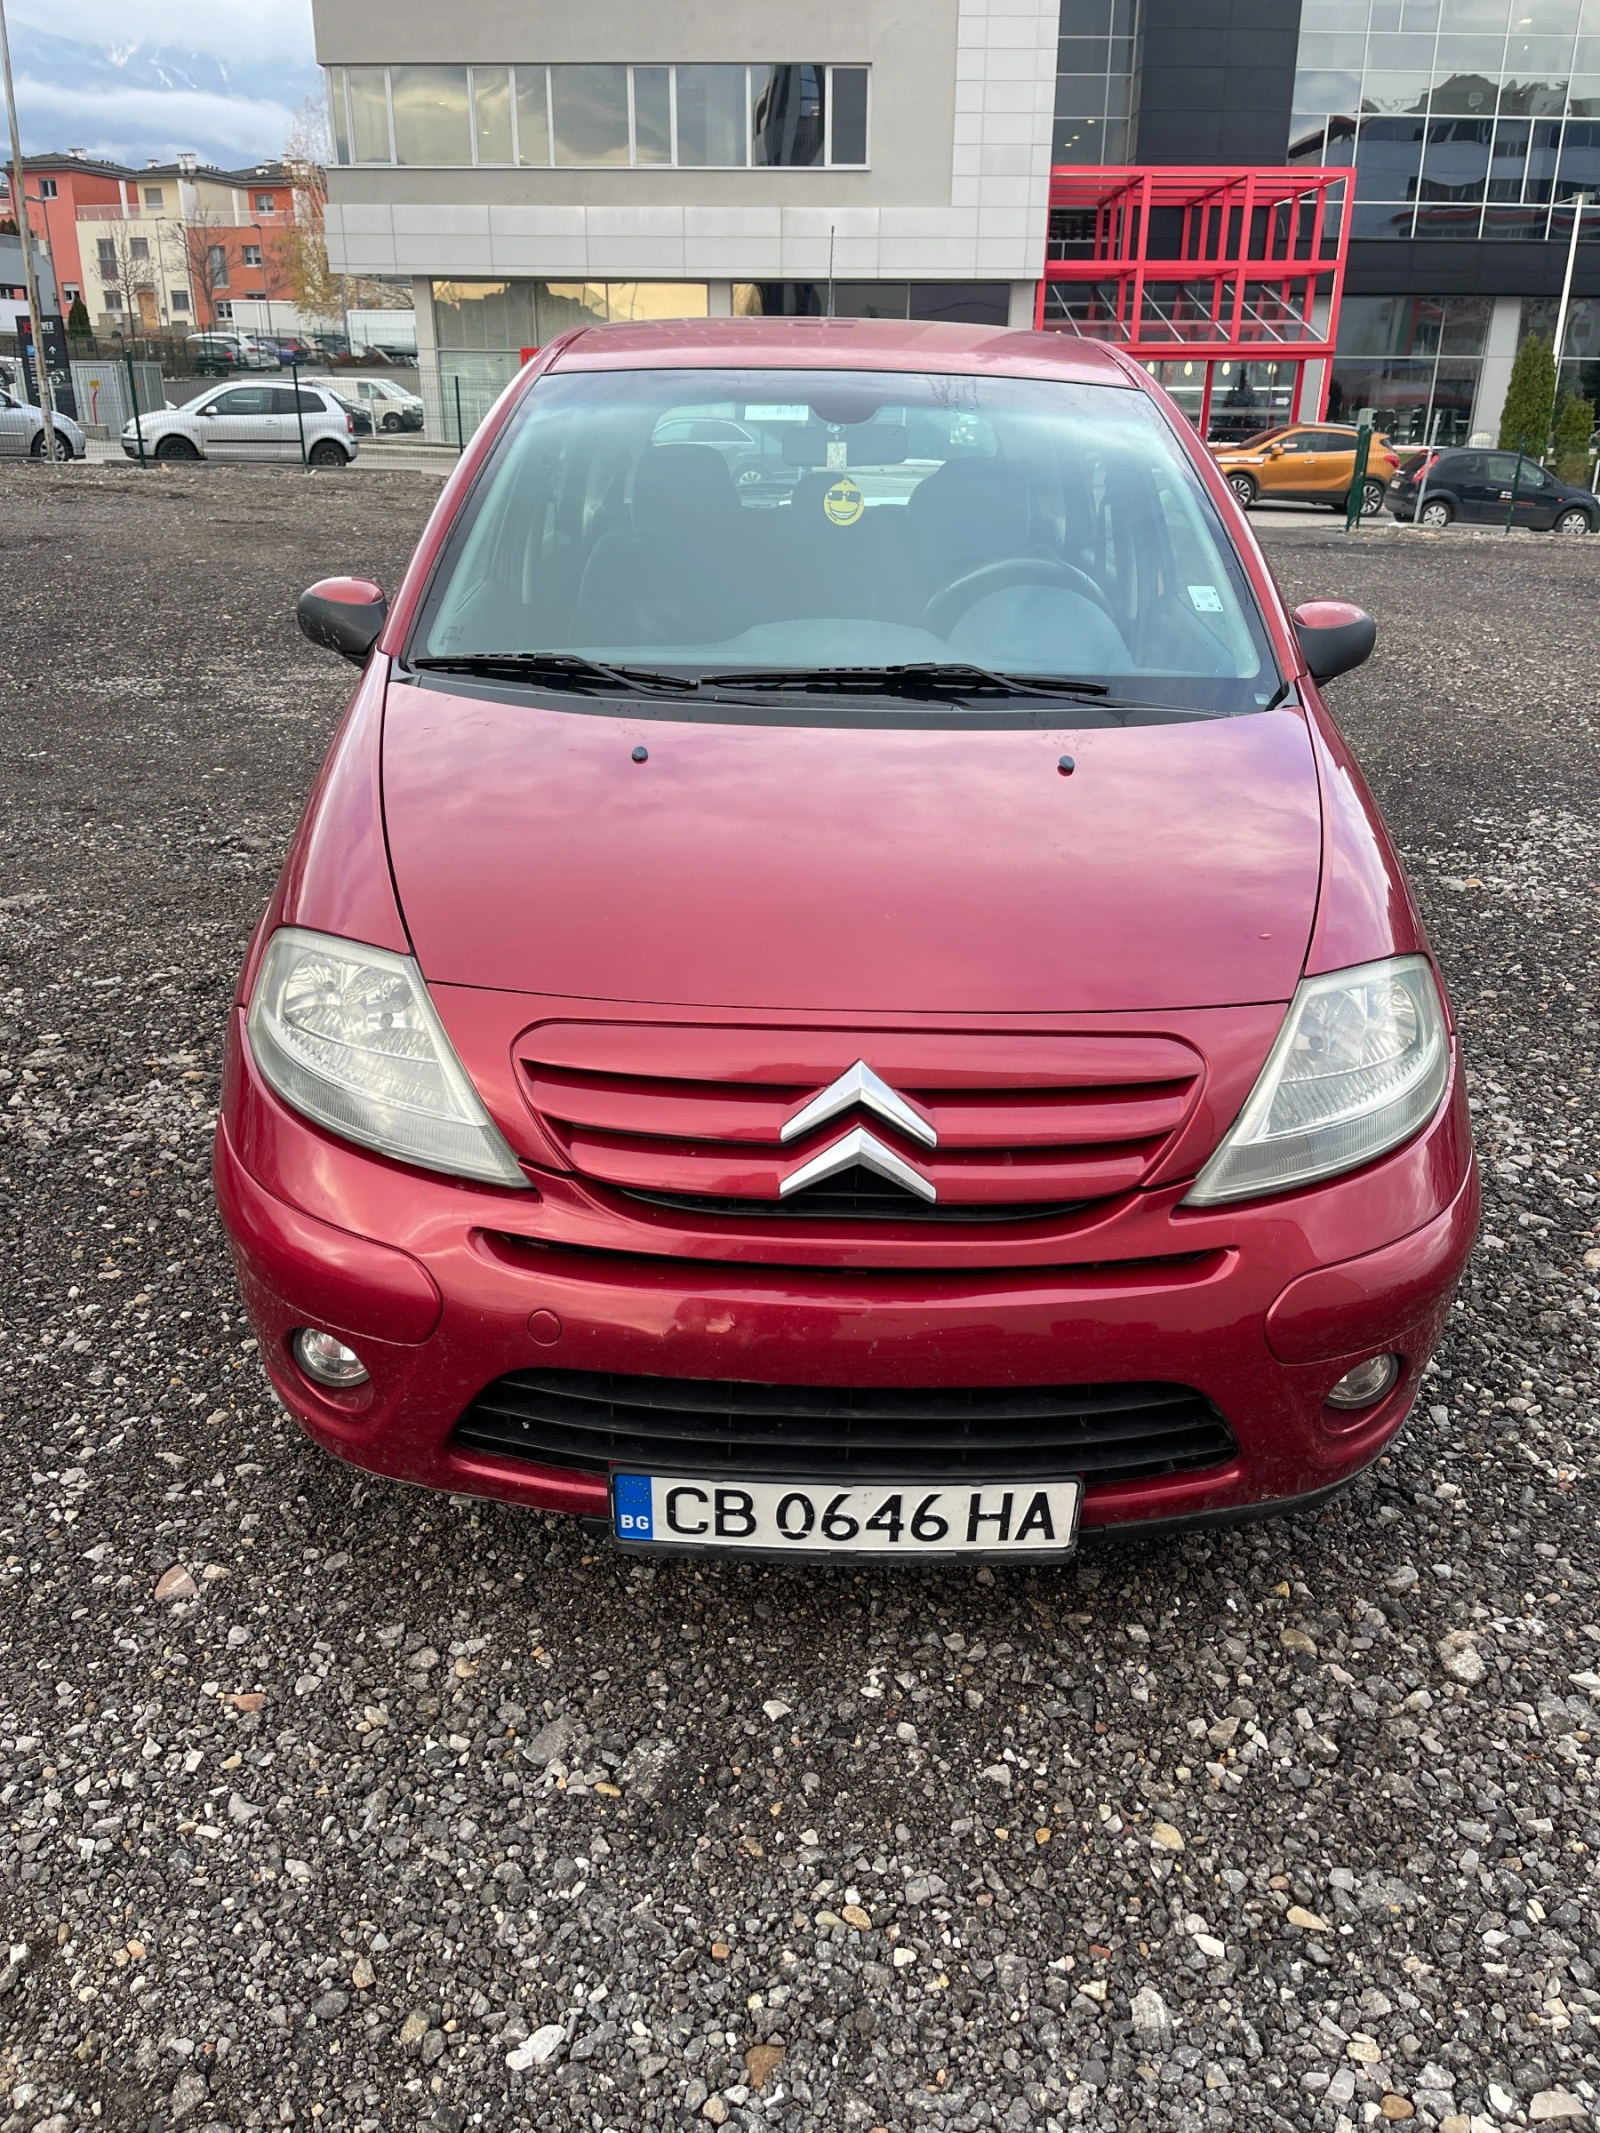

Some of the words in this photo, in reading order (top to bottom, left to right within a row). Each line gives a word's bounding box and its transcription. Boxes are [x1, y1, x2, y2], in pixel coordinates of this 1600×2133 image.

[621, 1514, 650, 1531] BG
[665, 1486, 757, 1538] CB
[775, 1491, 950, 1542] 0646
[965, 1491, 1056, 1542] HA
